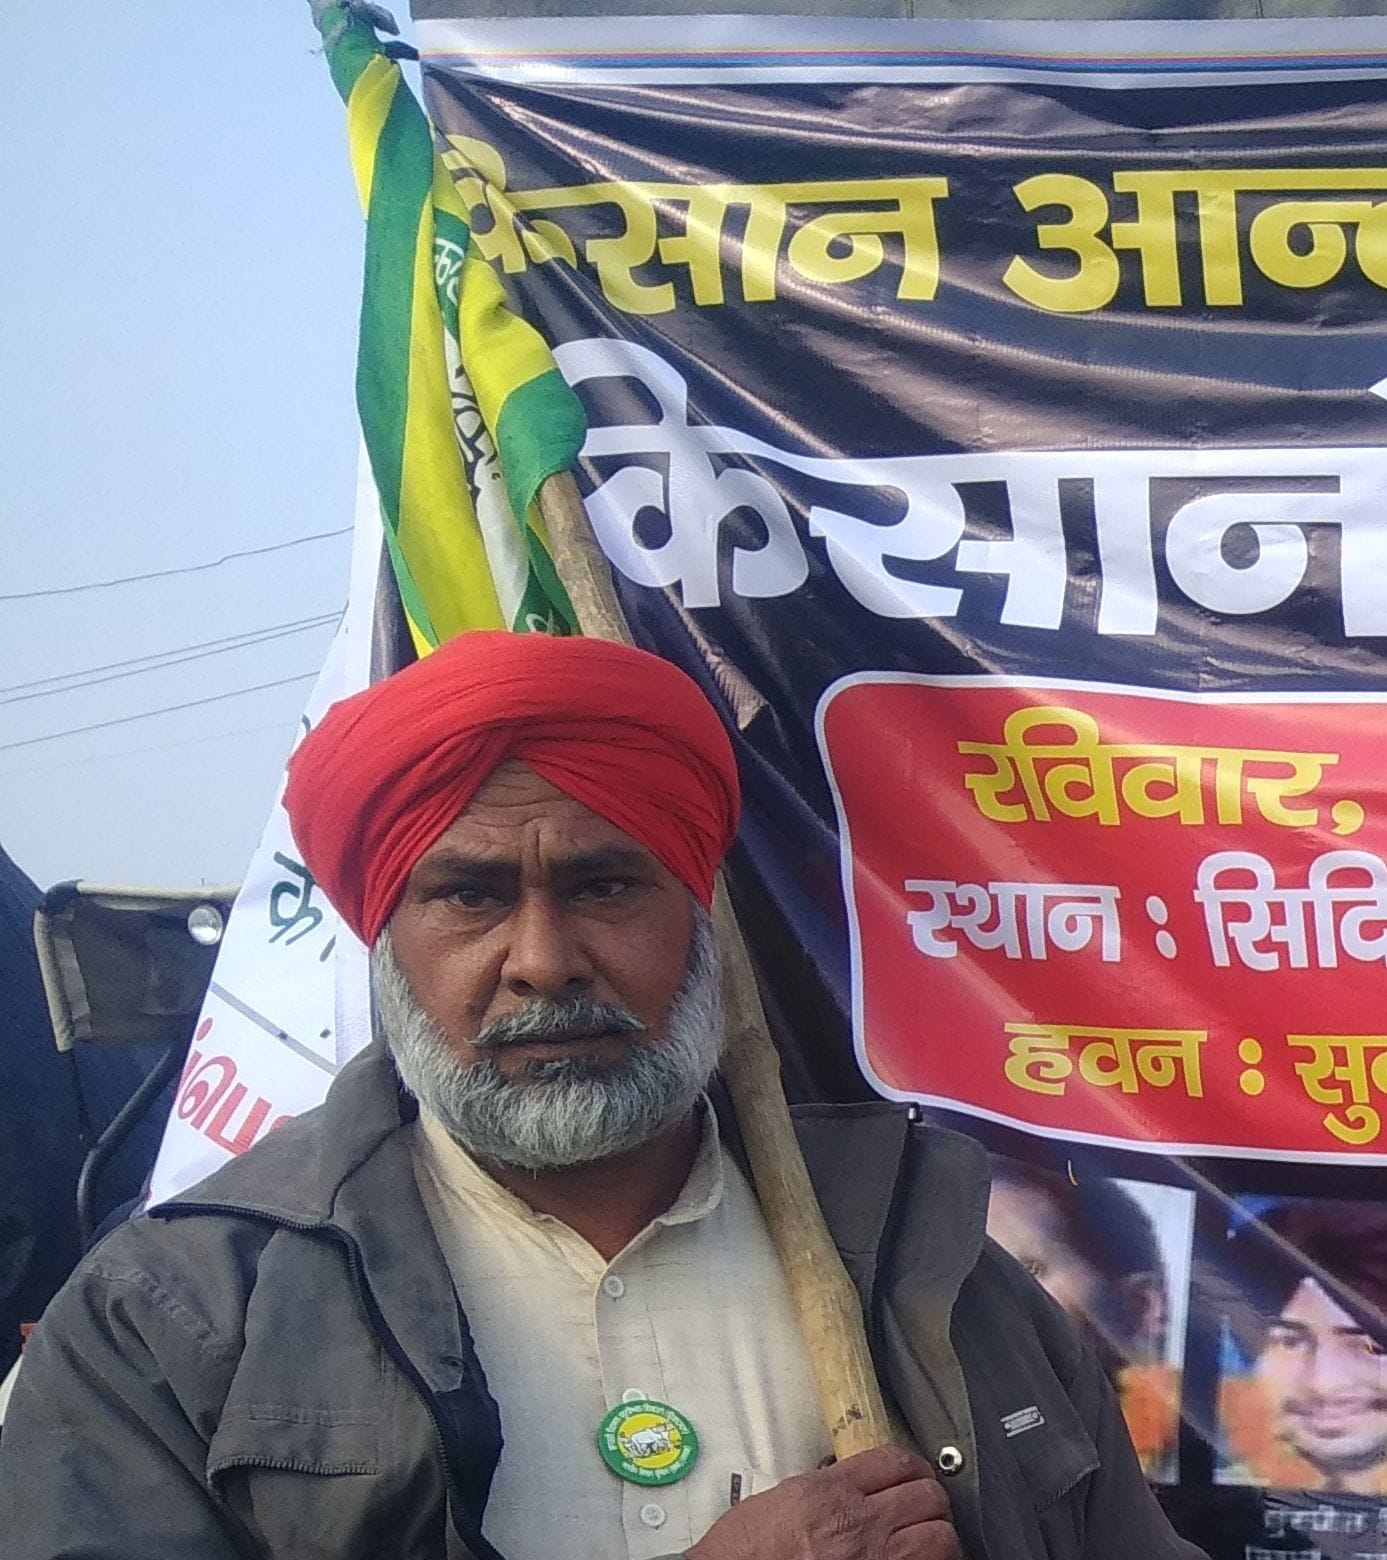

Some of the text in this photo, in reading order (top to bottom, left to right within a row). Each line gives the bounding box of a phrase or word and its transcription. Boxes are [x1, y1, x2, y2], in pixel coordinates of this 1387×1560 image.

[957, 706, 1363, 836] रविवार,
[905, 879, 1121, 962] स्थान
[1004, 1020, 1207, 1098] हवन
